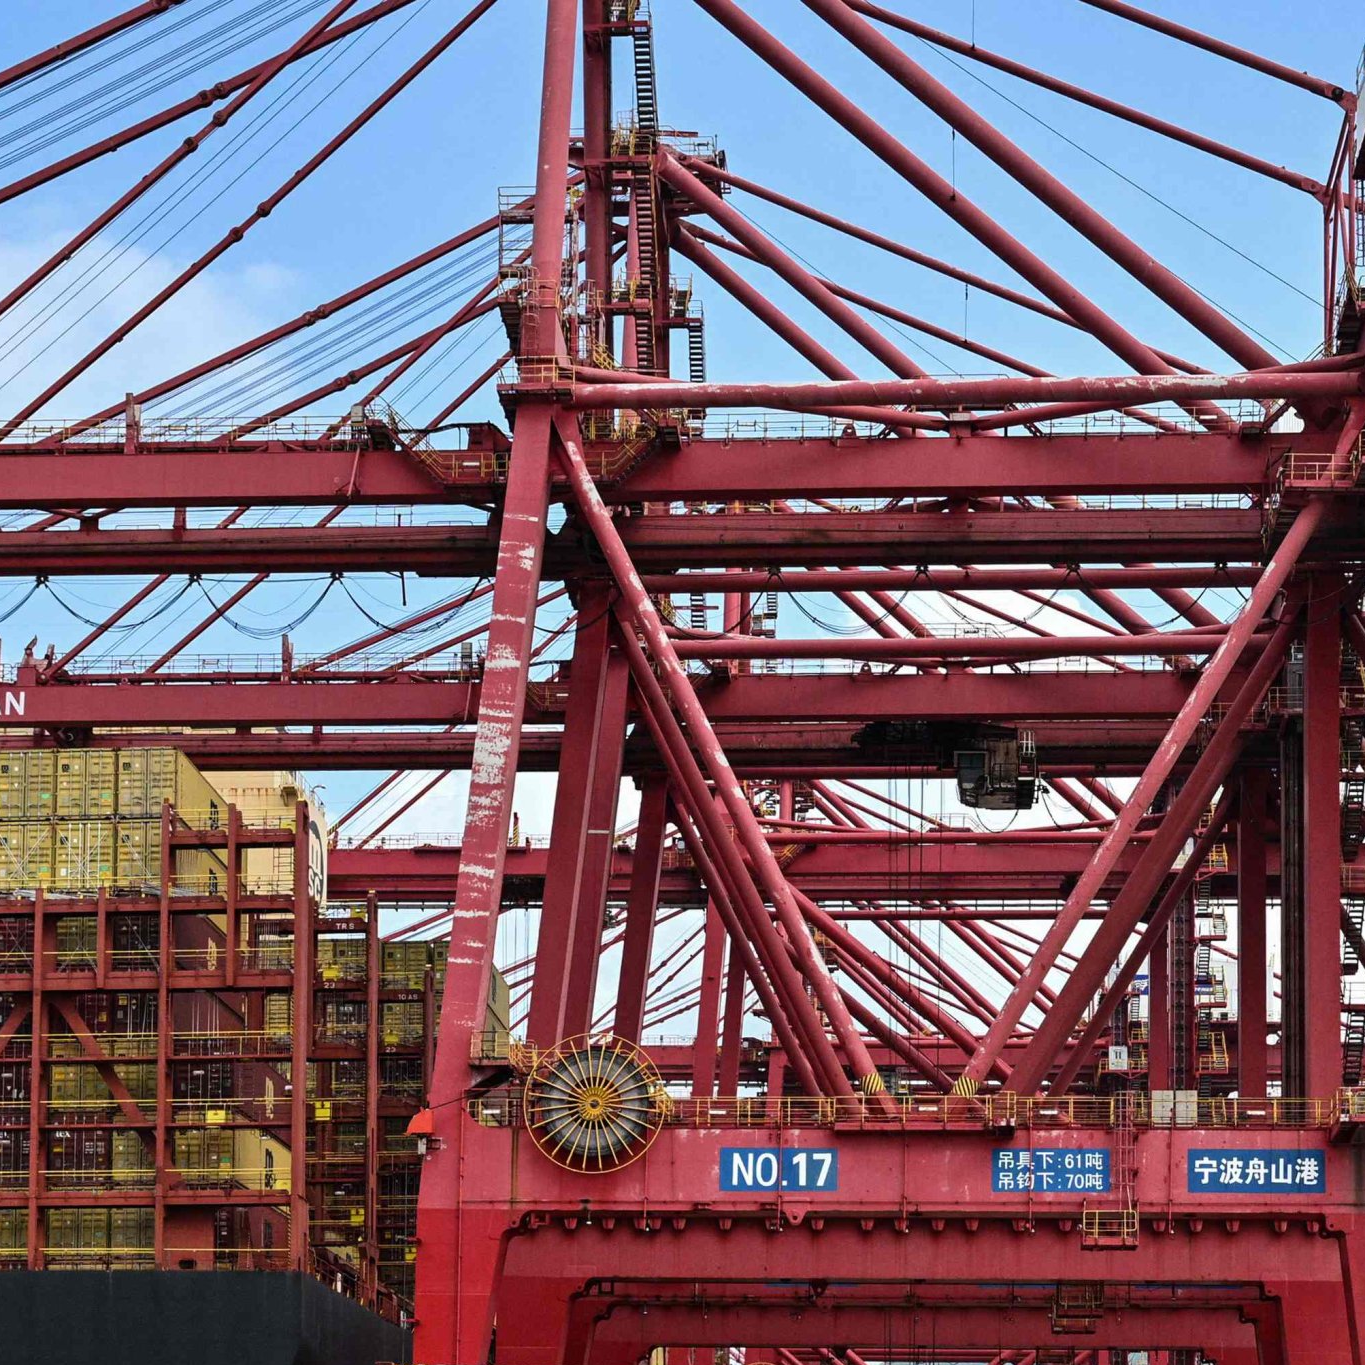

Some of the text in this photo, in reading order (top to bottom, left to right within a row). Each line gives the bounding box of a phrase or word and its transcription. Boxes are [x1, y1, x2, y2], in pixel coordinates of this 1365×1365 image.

[732, 1153, 832, 1186] NO.17
[1194, 1157, 1319, 1186] 宁波舟山港
